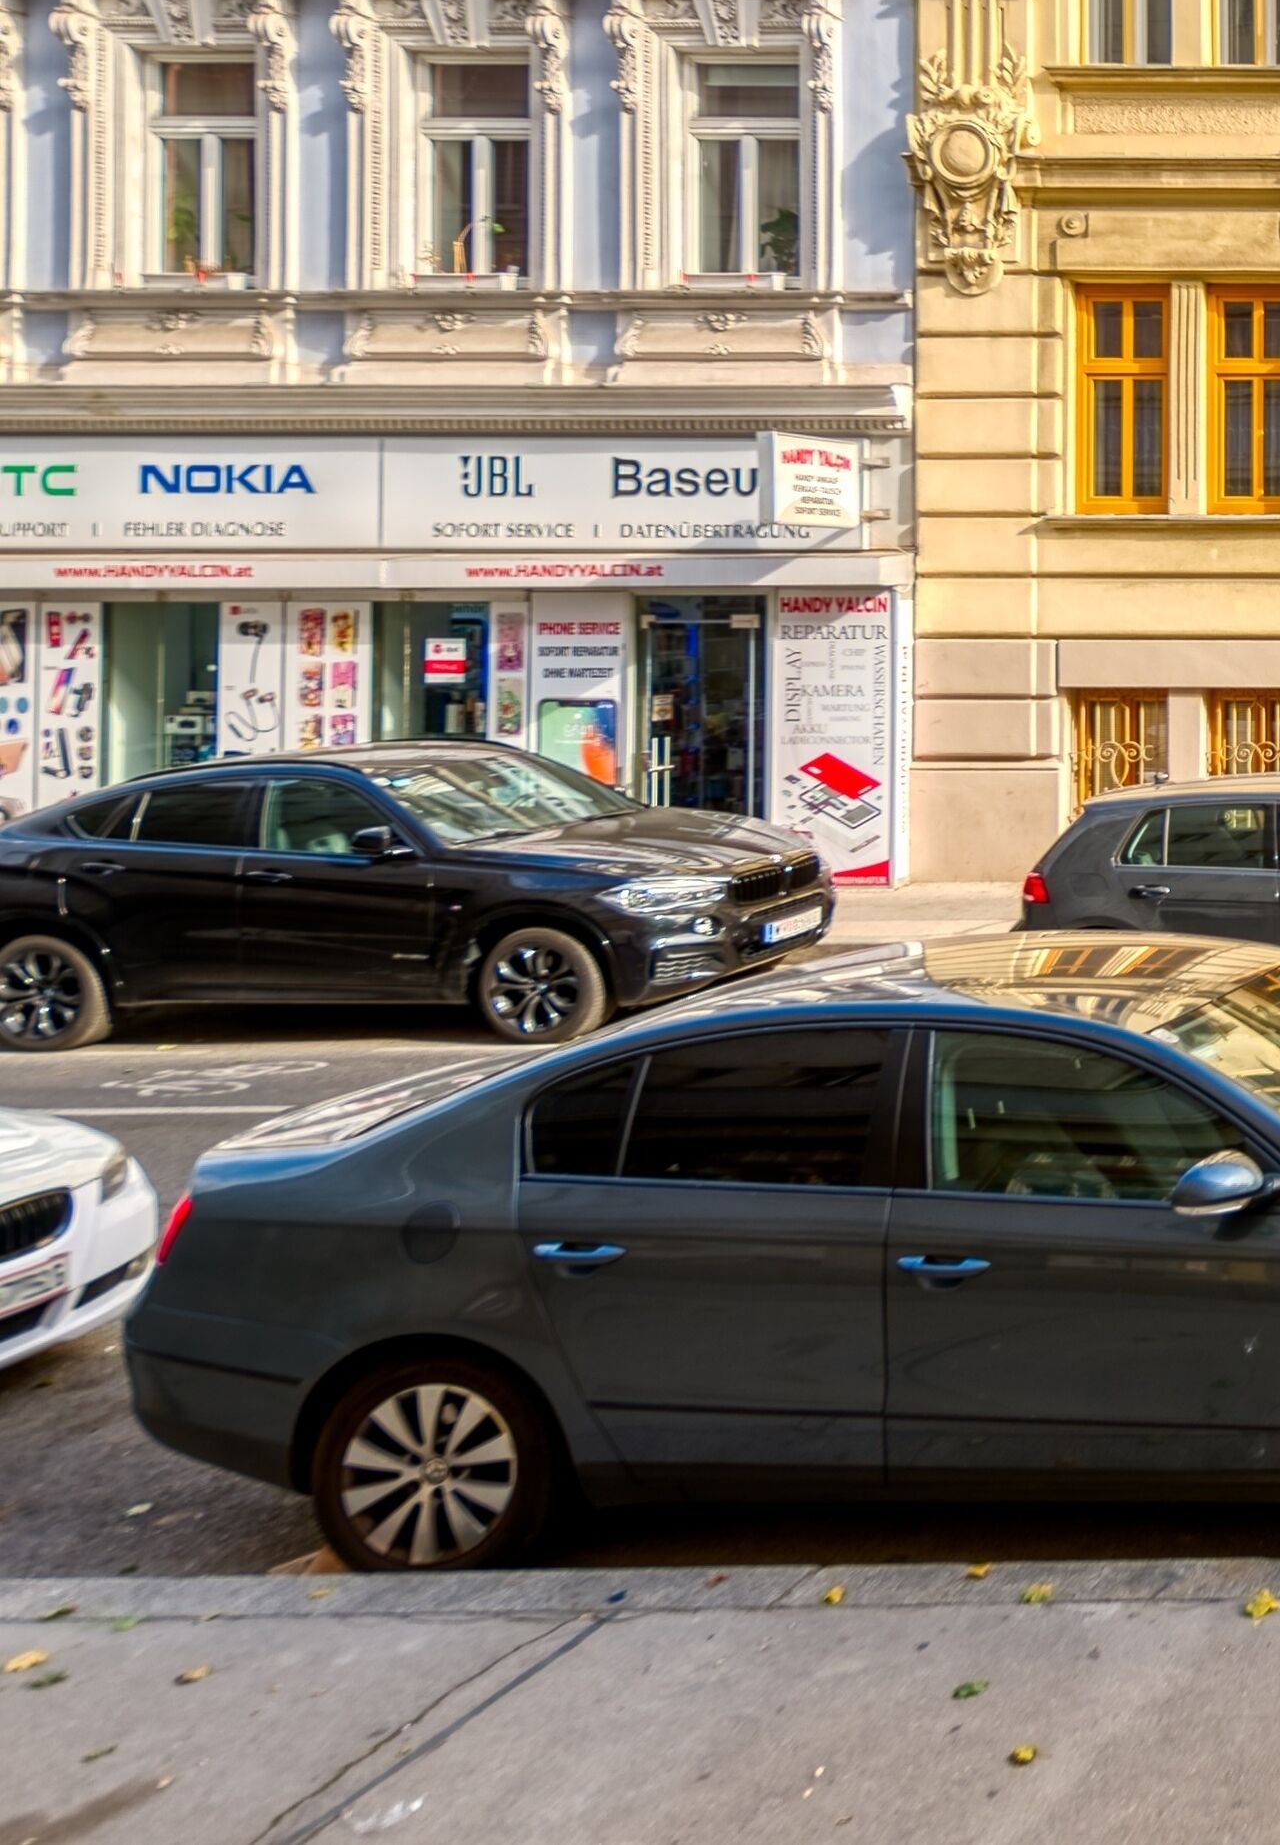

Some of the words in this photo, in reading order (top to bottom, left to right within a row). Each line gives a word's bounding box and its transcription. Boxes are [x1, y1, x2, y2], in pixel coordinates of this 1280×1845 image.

[139, 464, 317, 494] NOKIA
[459, 455, 534, 497] JBL
[124, 522, 185, 537] FEHLER
[191, 522, 287, 537] DIAGNOSE
[432, 522, 500, 538] SOFORT
[506, 522, 574, 538] SERVICE
[780, 597, 832, 612] HANDY
[537, 622, 576, 635] IPHONE
[578, 622, 621, 635] SERVICE
[780, 625, 888, 640] REPARATUR
[538, 645, 569, 657] SOFORT
[572, 645, 619, 657] REPARATUR
[543, 667, 566, 678] OHNE
[785, 647, 802, 722] DISPLAY
[800, 684, 865, 697] KAMERA
[873, 644, 886, 765] WASSERSCHADEN
